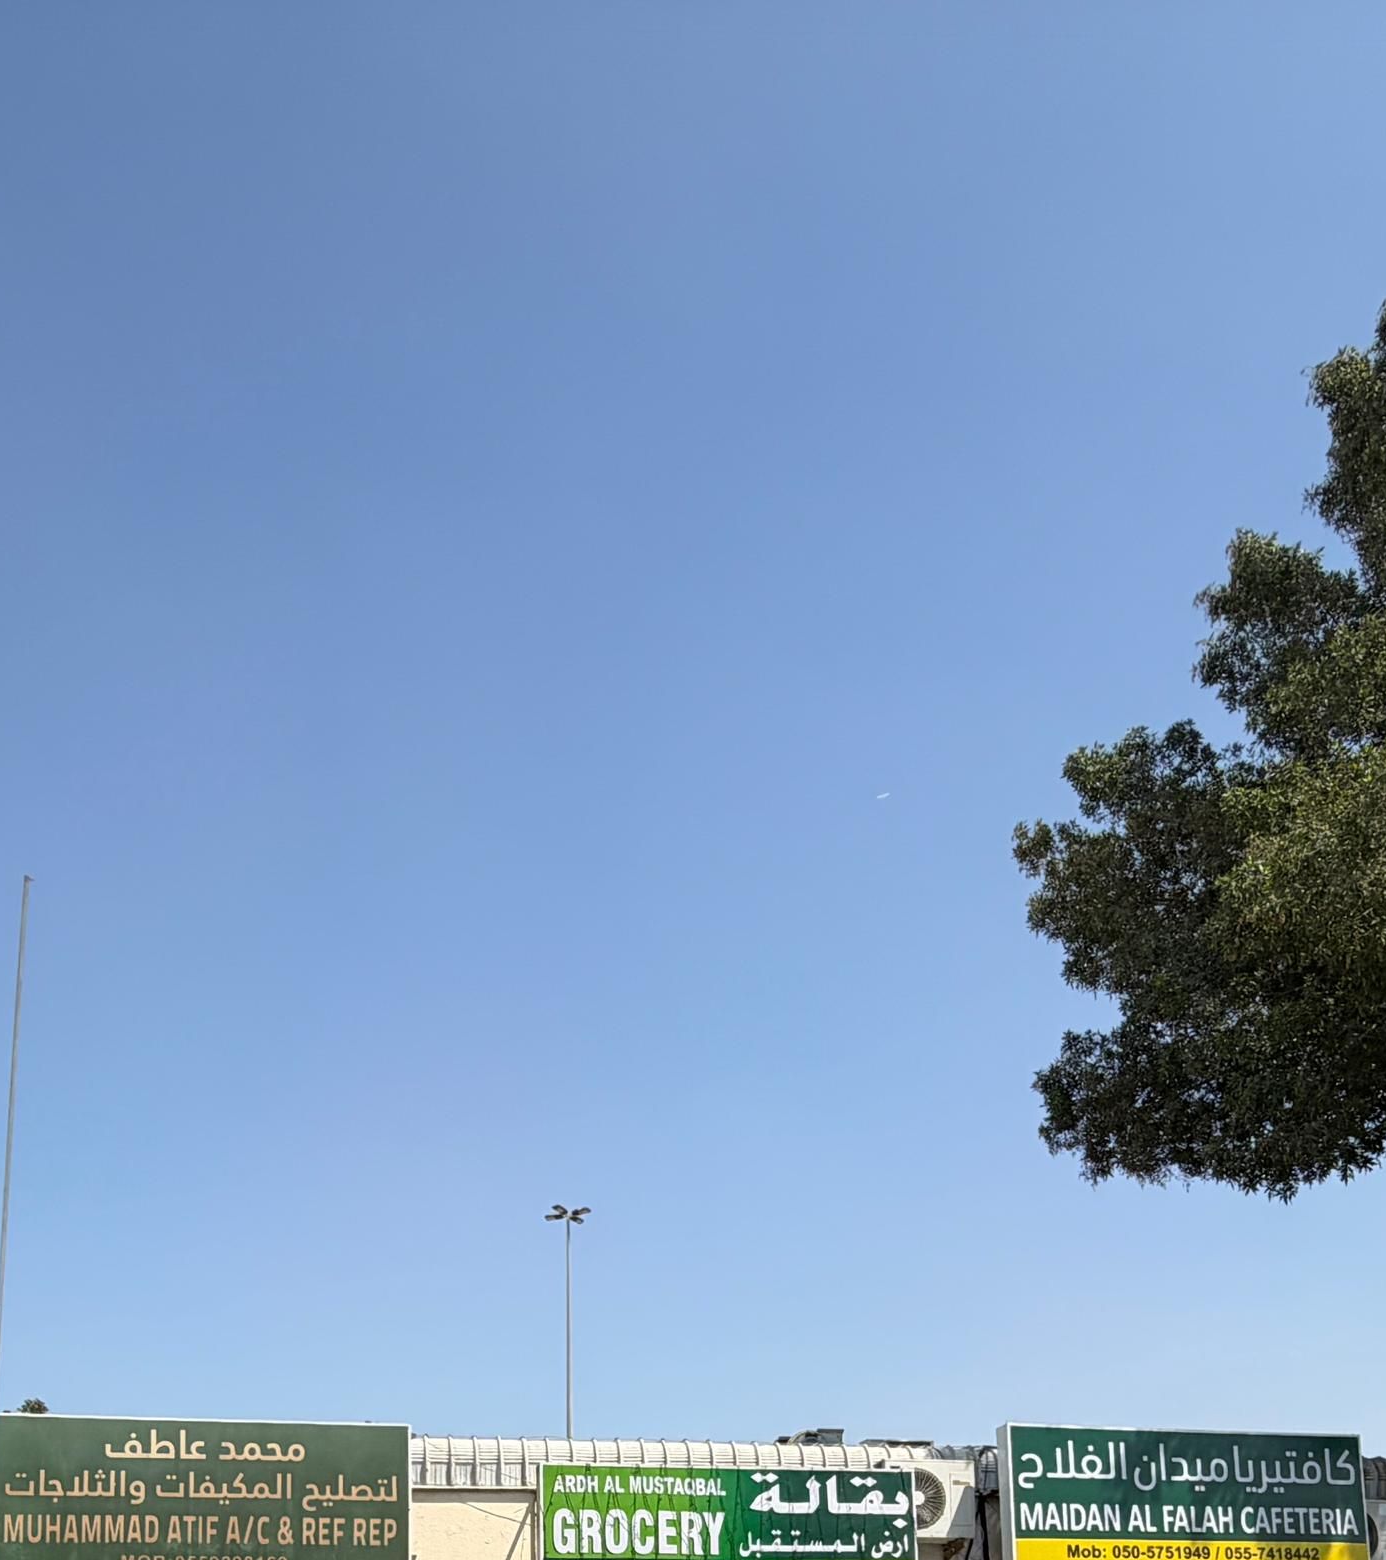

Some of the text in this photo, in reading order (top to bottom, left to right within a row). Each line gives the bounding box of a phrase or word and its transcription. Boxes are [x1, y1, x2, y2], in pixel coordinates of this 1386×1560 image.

[104, 1429, 307, 1462] محمد عاطف
[1017, 1439, 1356, 1494] كافتيريا ميدان الفلاح
[4, 1468, 398, 1512] لتصليح المكيفات والثلاجات
[553, 1474, 727, 1497] ARDH AL MUSTAQBAL
[748, 1471, 911, 1529] بقالة
[2, 1513, 398, 1547] MUHAMMAD ATIF A/C & REF REP
[552, 1508, 726, 1557] GROCERY
[1020, 1502, 1359, 1536] MAIDAN AL FALAH CAFETERIA
[739, 1529, 910, 1558] ارض المستقبل
[1066, 1544, 1107, 1559] Mob:
[1112, 1545, 1211, 1560] 050-5751949
[1225, 1546, 1320, 1560] 055-7418442
